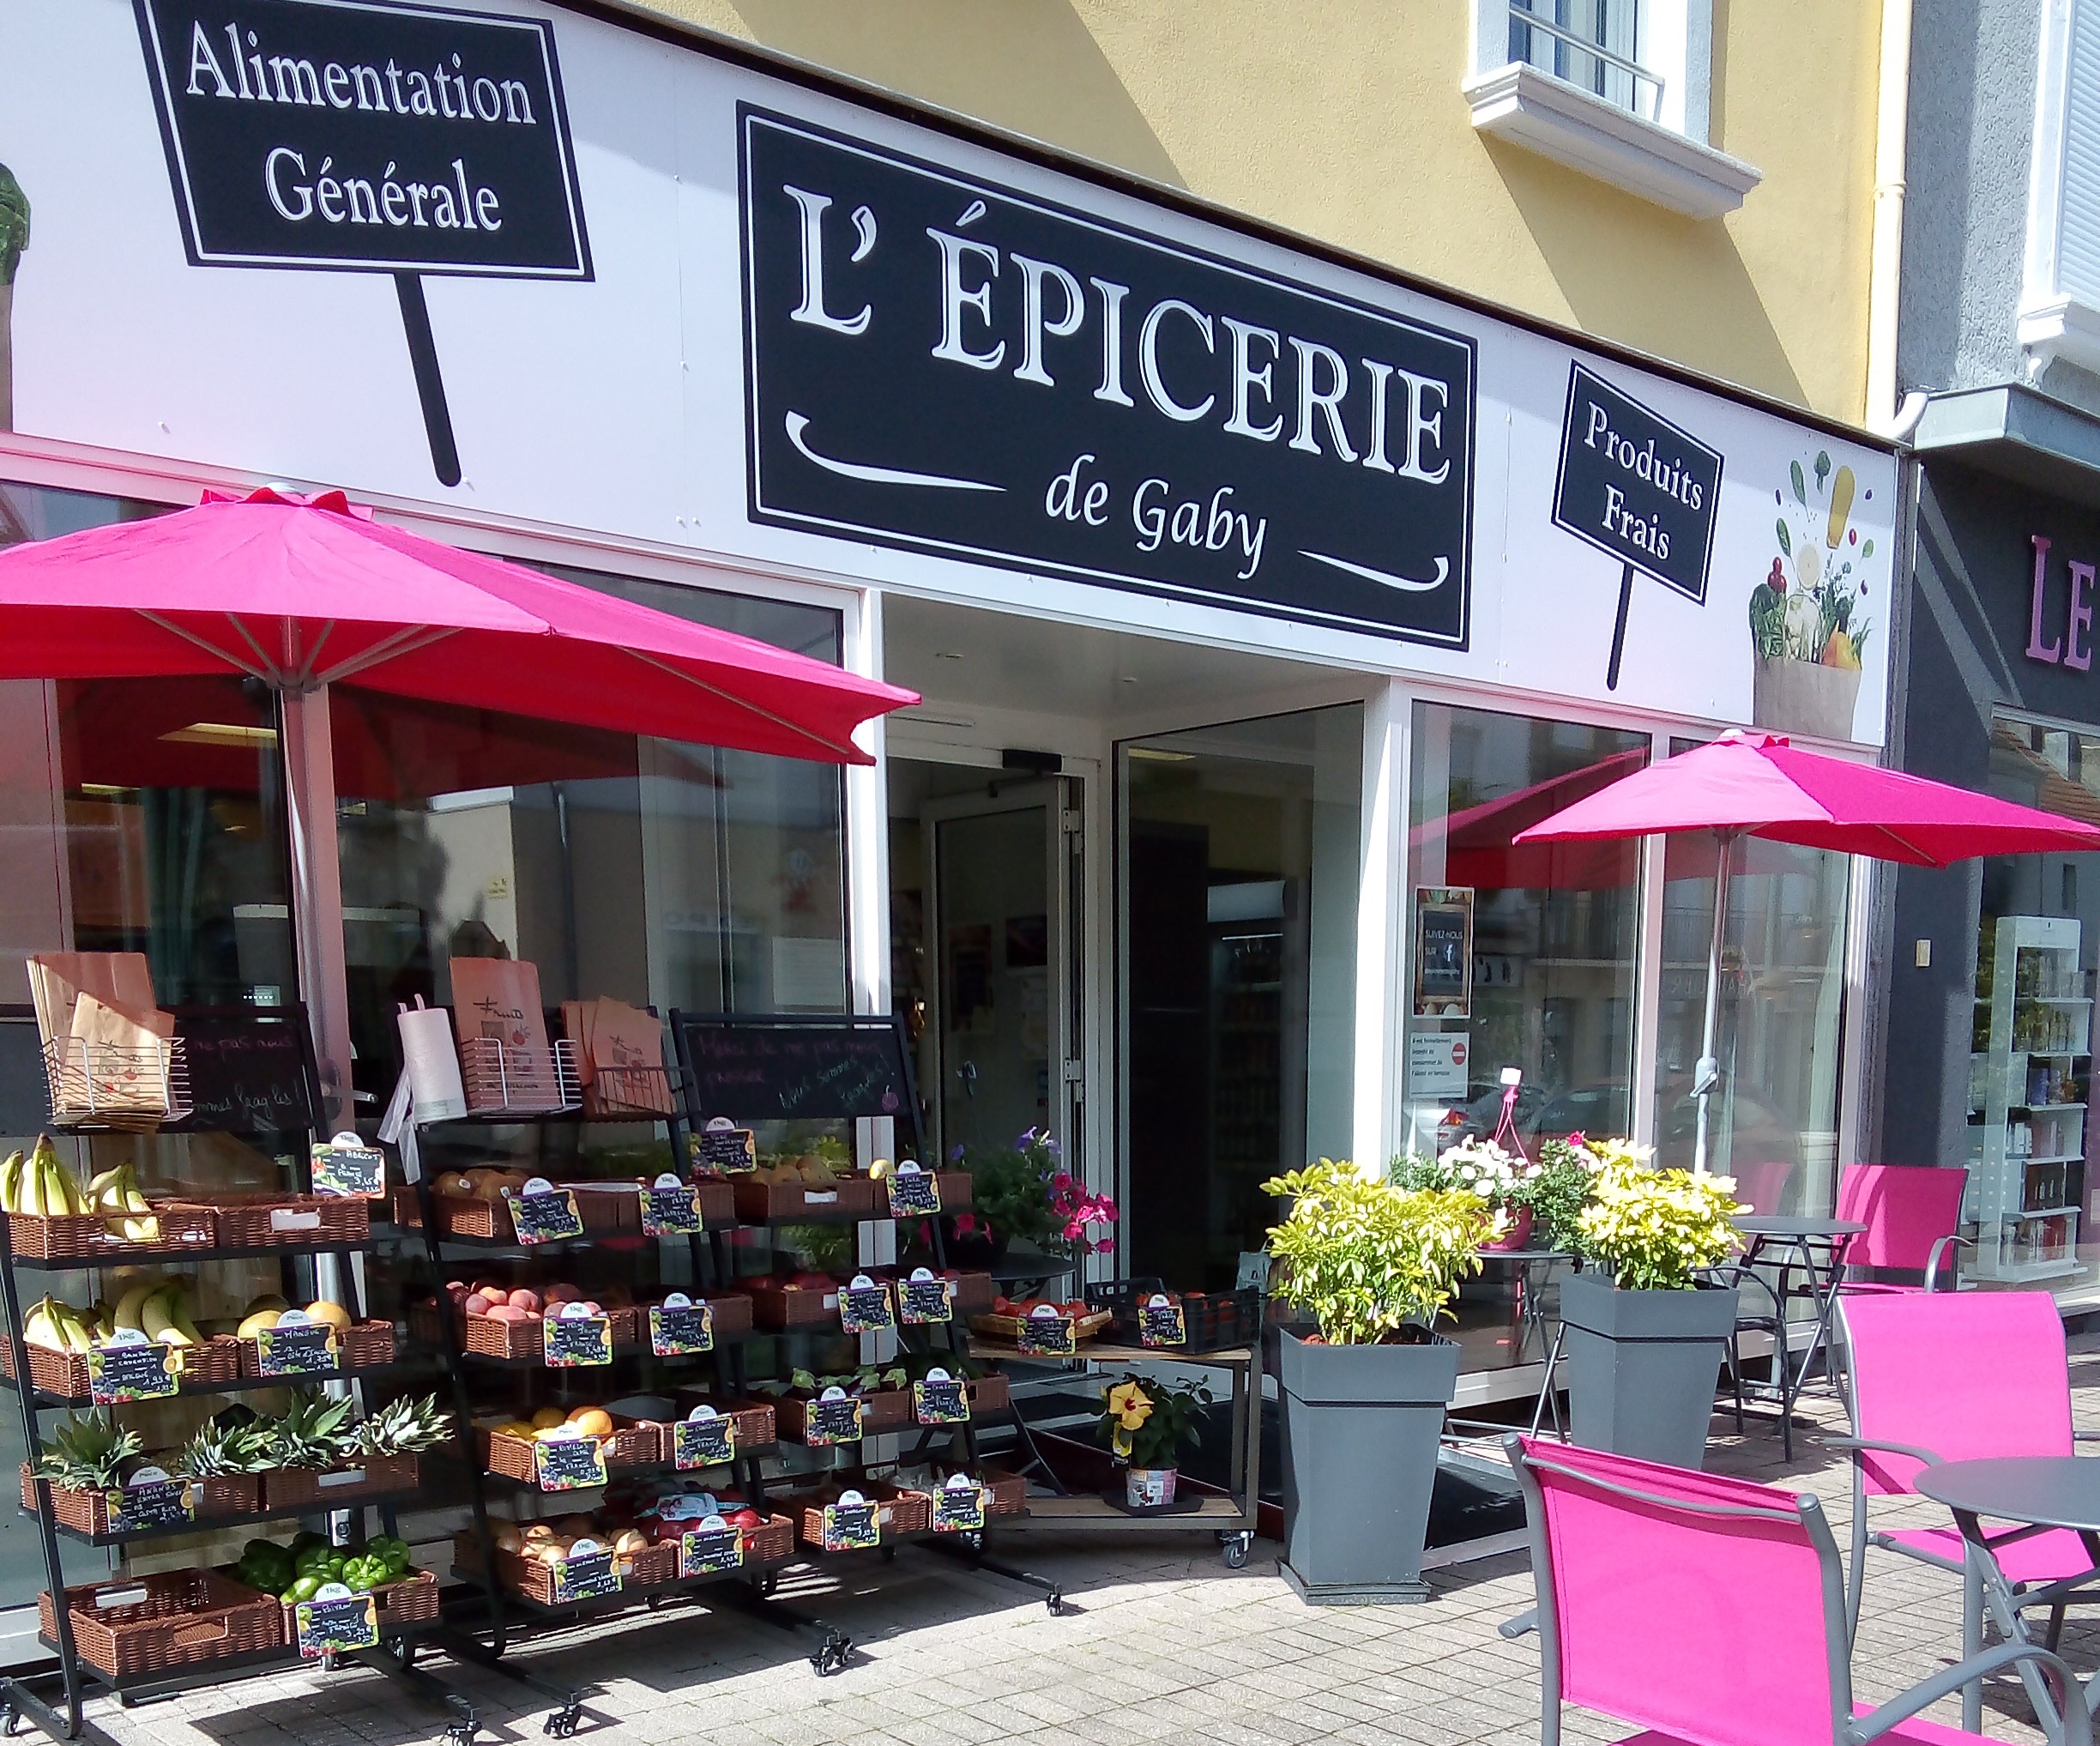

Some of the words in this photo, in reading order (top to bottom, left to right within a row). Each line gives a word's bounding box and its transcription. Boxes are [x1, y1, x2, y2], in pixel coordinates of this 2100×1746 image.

[185, 20, 536, 125] Alimentation
[265, 147, 503, 232] Générale
[926, 199, 1452, 486] ÉPICERIE
[1583, 401, 1704, 511] Produits
[1045, 453, 1109, 526] de
[1132, 478, 1268, 581] Gaby
[1601, 483, 1671, 561] Frais
[2025, 535, 2096, 672] LE
